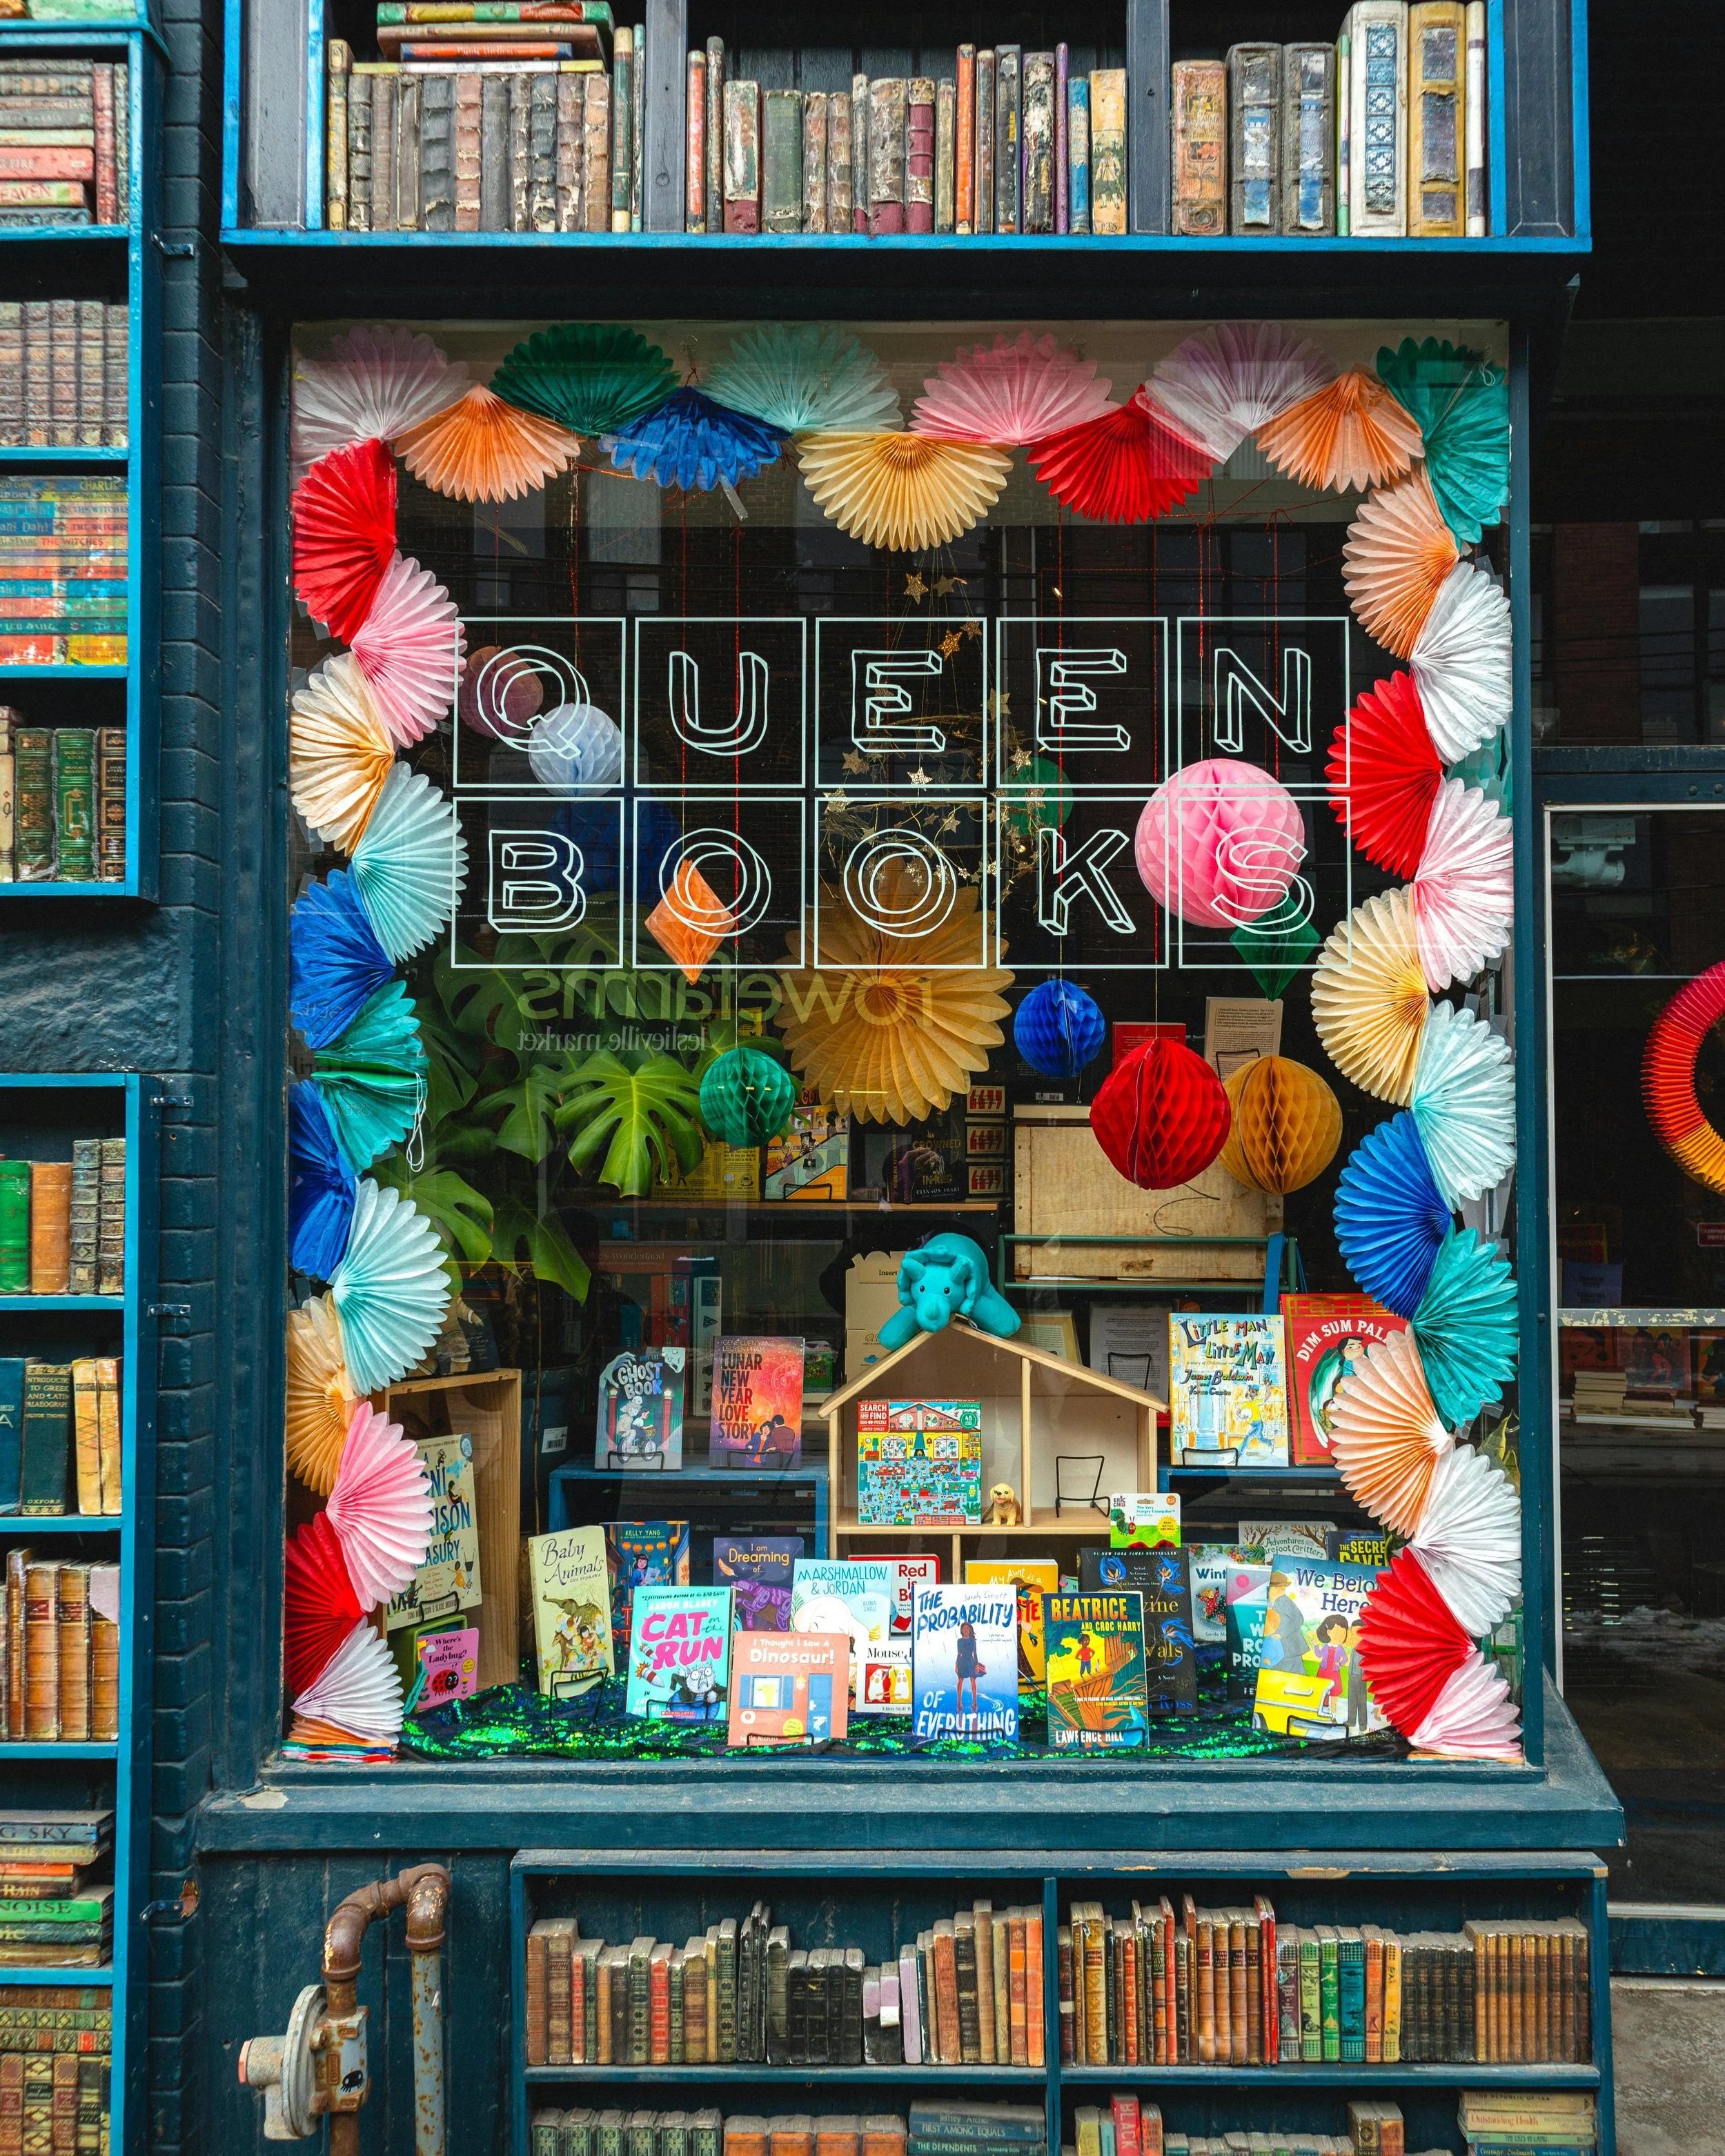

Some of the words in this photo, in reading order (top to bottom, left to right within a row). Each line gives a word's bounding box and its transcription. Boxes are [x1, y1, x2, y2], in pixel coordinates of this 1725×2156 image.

[41, 537, 59, 546] THE
[61, 537, 103, 546] WITCHES
[477, 644, 1312, 760] QUEEN
[488, 827, 1314, 937] BOOKS
[912, 1139, 961, 1151] CROWNED
[1236, 1318, 1268, 1337] MAN
[1297, 1332, 1322, 1363] DIM
[1321, 1319, 1353, 1338] SUM
[1357, 1319, 1387, 1344] PAL
[721, 1352, 762, 1370] LUNAR
[1235, 1341, 1276, 1370] MAN
[617, 1361, 663, 1385] GHOST
[720, 1370, 750, 1387] NEW
[1180, 1369, 1212, 1385] James
[1211, 1369, 1254, 1385] Baldwin
[624, 1380, 663, 1400] BOOK
[720, 1387, 753, 1405] YEAR
[719, 1405, 749, 1422] LOVE
[718, 1422, 758, 1440] STORY
[424, 1452, 429, 1464] A
[1265, 1537, 1305, 1547] Adventures
[541, 1537, 585, 1567] Baby
[729, 1547, 789, 1566] Dreaming
[1292, 1545, 1324, 1559] Critters
[1339, 1552, 1389, 1567] RAVE
[544, 1555, 604, 1585] Animals
[580, 1573, 601, 1581] FUJIKAWA
[798, 1566, 887, 1581] MARSHMALLOW
[898, 1563, 927, 1577] Red
[1007, 1567, 1025, 1582] Aunt
[1027, 1572, 1034, 1581] is
[811, 1581, 820, 1595] &
[1295, 1567, 1325, 1588] We
[1332, 1572, 1381, 1594] Belo
[917, 1590, 943, 1612] THE
[963, 1590, 981, 1601] Sarah
[1321, 1592, 1370, 1614] Here
[1051, 1597, 1128, 1621] BEATRICE
[640, 1611, 709, 1642] CAT
[917, 1603, 1014, 1641] PROBABILITY
[1081, 1622, 1093, 1630] AND
[1095, 1621, 1114, 1632] CROC
[1117, 1621, 1141, 1632] HARRY
[435, 1635, 461, 1646] Where's
[443, 1643, 453, 1652] the
[760, 1639, 793, 1648] Thought
[428, 1650, 467, 1663] Ladybug?
[652, 1636, 724, 1670] RUN
[750, 1649, 835, 1665] Dinosaur!
[867, 1648, 904, 1658] Mouse
[923, 1690, 946, 1708] OF
[1159, 1694, 1193, 1710] Ross
[916, 1708, 1016, 1740] EVERYTHING
[1105, 1730, 1124, 1742] HILL
[28, 1827, 71, 1839] SKY
[0, 1902, 72, 1914] NOISE
[939, 2113, 960, 2124] Jeffrey
[1121, 2103, 1137, 2149] BLACK
[1471, 2113, 1514, 2128] Outstanding
[1515, 2115, 1539, 2126] Health
[922, 2124, 940, 2134] FIRST
[944, 2125, 974, 2136] AMONG
[977, 2126, 1005, 2139] EQUALS
[917, 2142, 930, 2150] THE
[932, 2142, 977, 2153] DEPENDENTS
